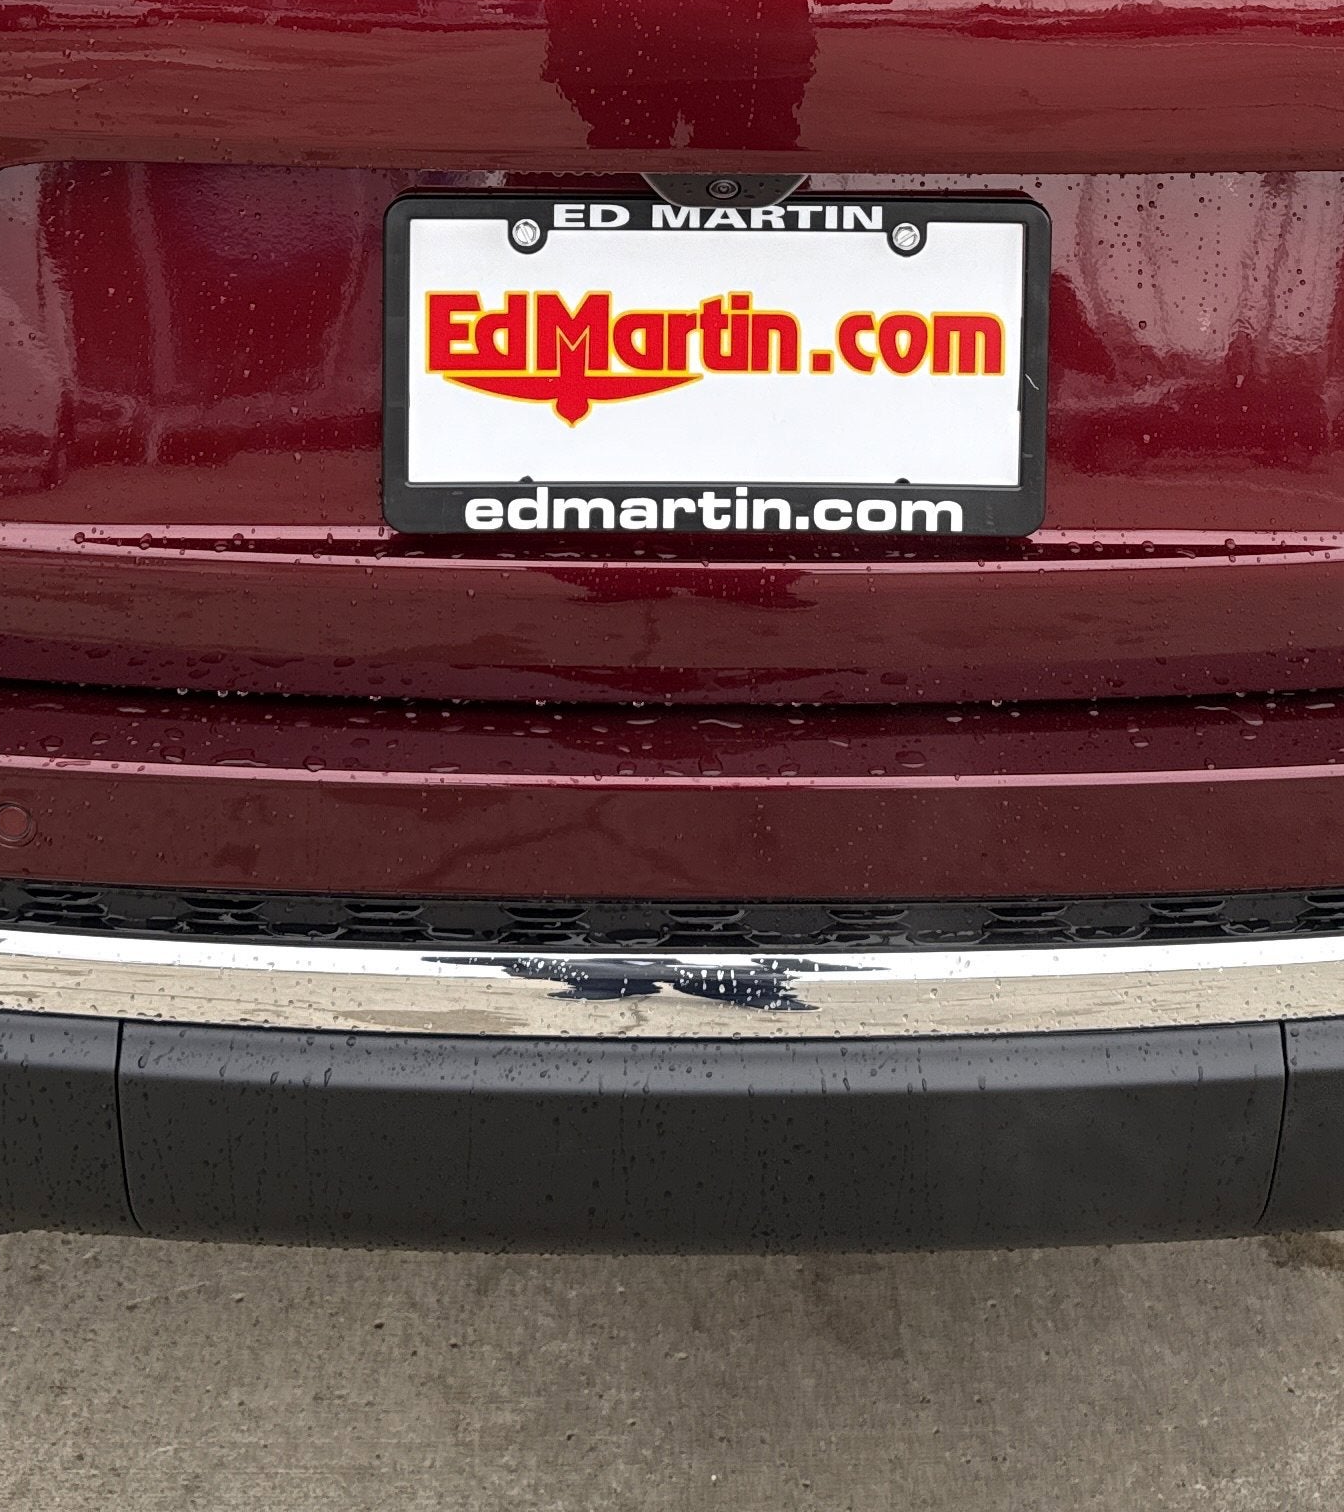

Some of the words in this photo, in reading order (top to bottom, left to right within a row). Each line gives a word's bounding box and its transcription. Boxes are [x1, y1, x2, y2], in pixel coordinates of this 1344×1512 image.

[553, 204, 630, 229] ED
[651, 204, 884, 230] MARTIN
[424, 291, 1006, 376] EdMartin.com
[464, 486, 964, 532] edmartin.com
